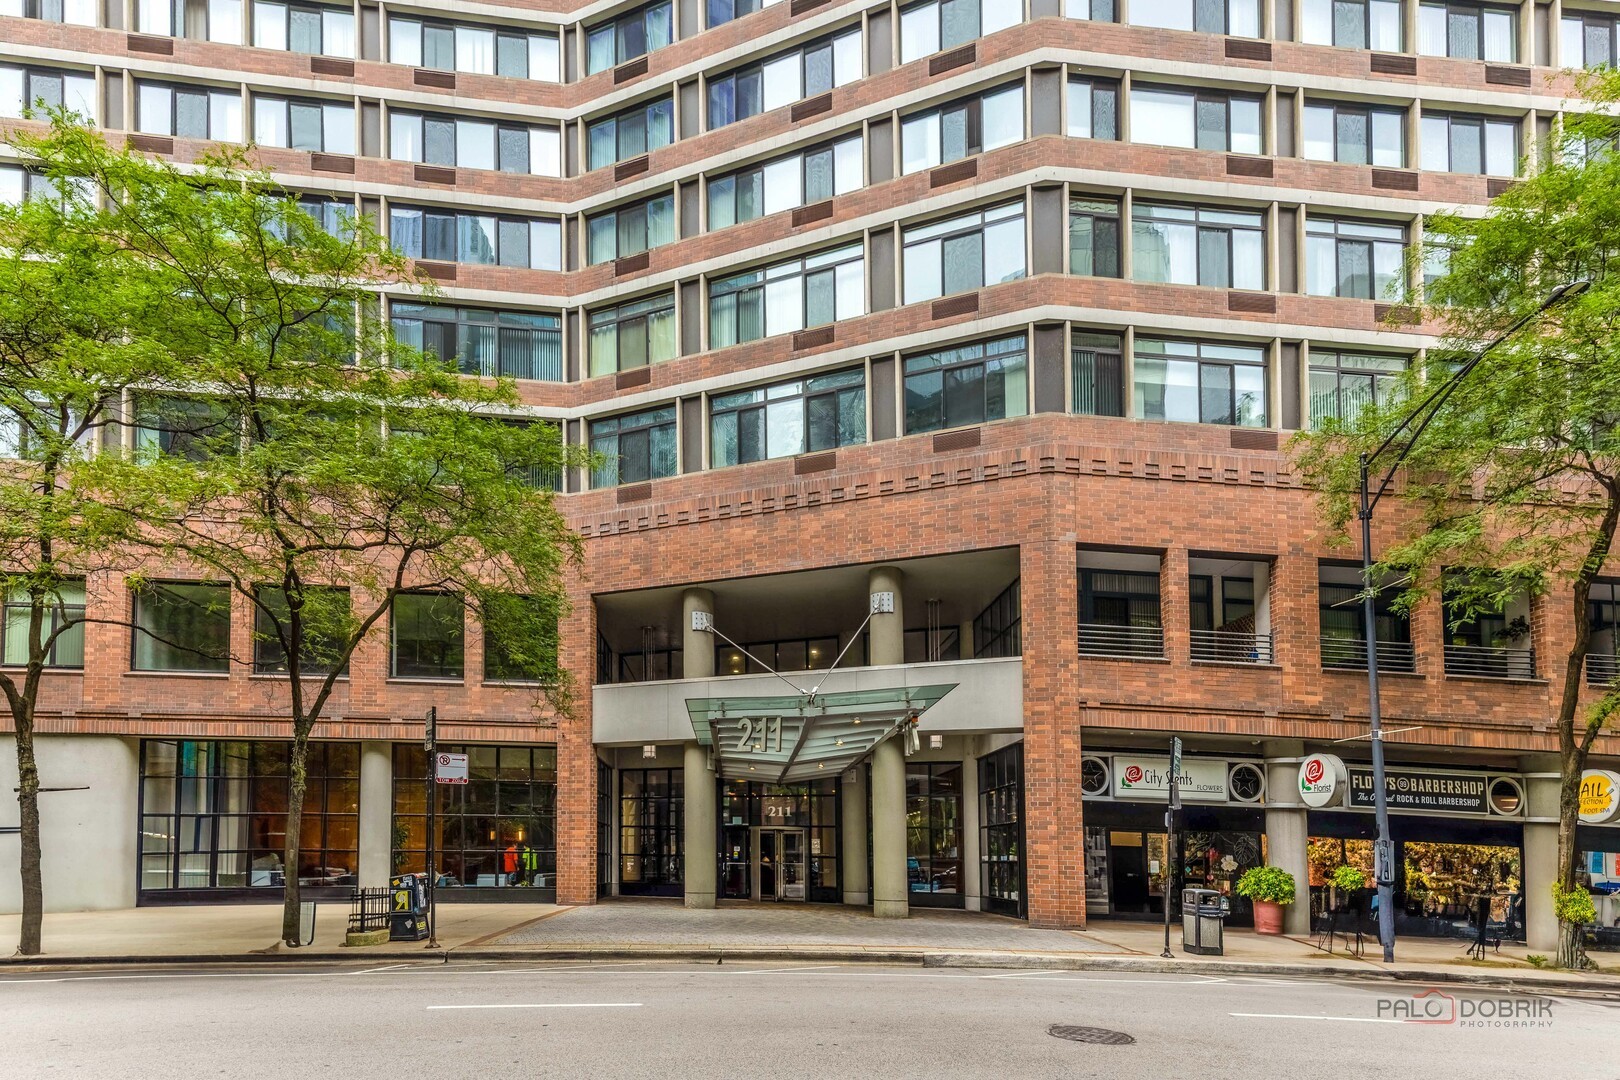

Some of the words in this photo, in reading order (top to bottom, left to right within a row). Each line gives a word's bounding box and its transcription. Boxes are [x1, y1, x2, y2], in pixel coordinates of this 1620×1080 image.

[736, 717, 782, 752] 211
[1144, 769, 1163, 787] City
[1165, 770, 1193, 786] Sents
[1352, 775, 1396, 790] FLO'S
[1410, 778, 1484, 796] BARBERSHOP
[1196, 784, 1223, 792] FLOWERS
[1313, 782, 1332, 793] Florist
[1581, 782, 1603, 798] AIL
[1357, 792, 1368, 801] The
[1396, 795, 1414, 803] ROCK
[1415, 796, 1420, 804] &
[1421, 796, 1437, 805] ROLL
[1438, 797, 1480, 807] BARBERSHOP
[767, 806, 793, 817] 211
